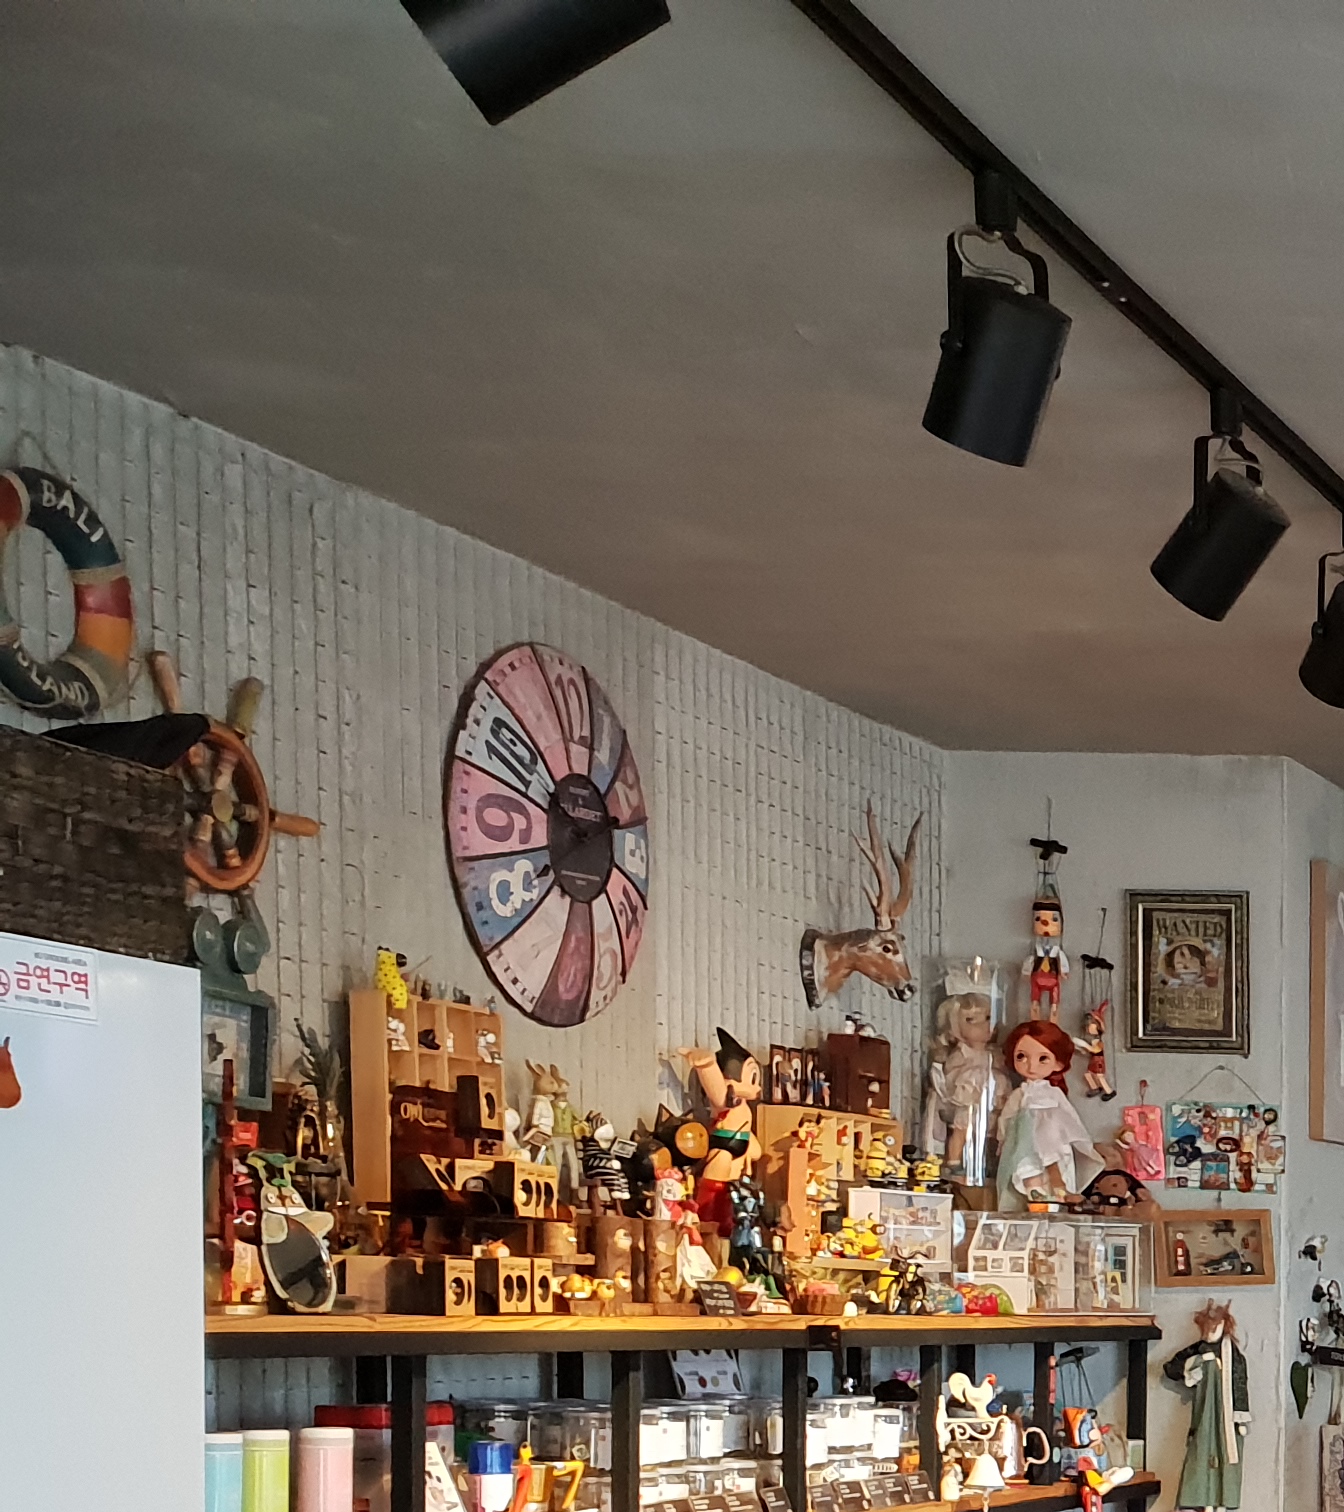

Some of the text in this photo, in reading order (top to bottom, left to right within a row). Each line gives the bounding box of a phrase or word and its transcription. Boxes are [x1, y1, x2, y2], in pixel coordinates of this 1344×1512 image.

[40, 479, 103, 543] BALI
[1155, 917, 1224, 938] WANTED
[13, 960, 90, 999] 금연구역
